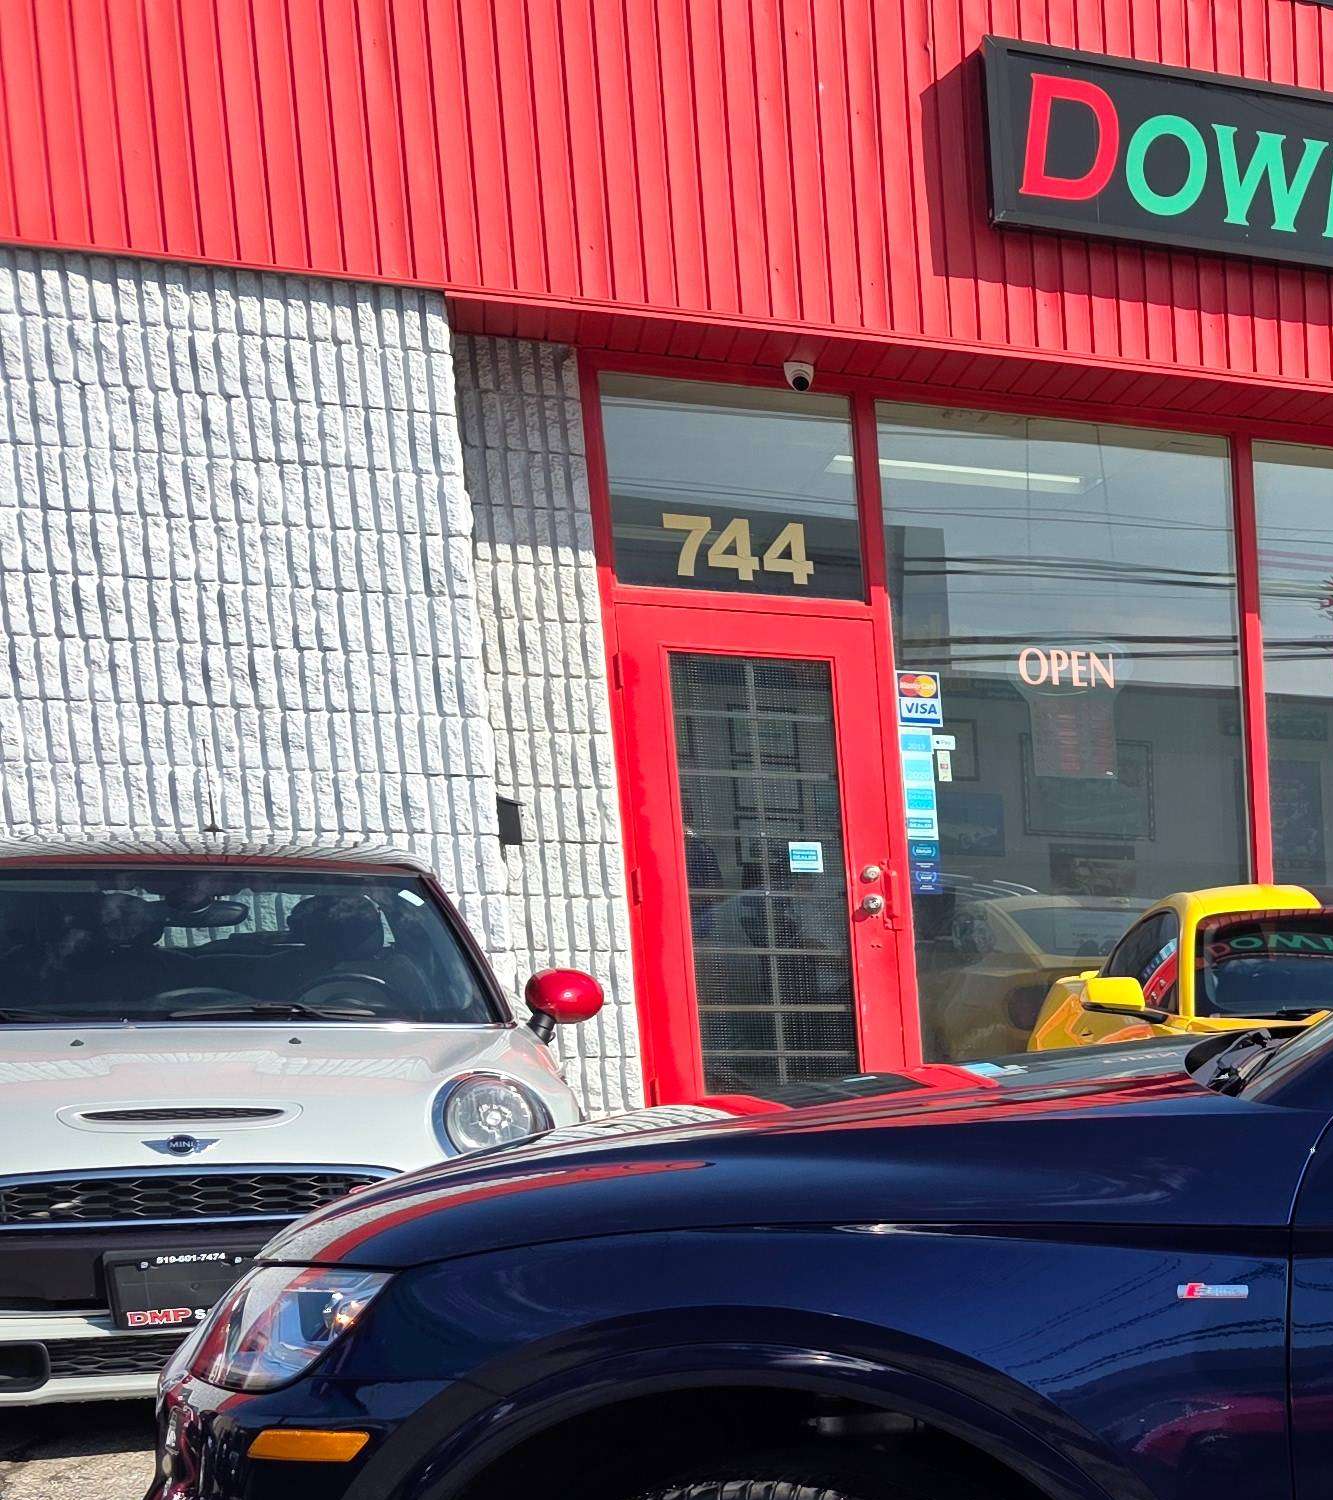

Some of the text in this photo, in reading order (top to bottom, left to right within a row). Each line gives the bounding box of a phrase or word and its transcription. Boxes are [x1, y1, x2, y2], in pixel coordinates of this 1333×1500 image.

[662, 512, 815, 585] 744
[1018, 647, 1115, 689] OPEN
[905, 702, 937, 715] VISA
[127, 1307, 192, 1327] DMP
